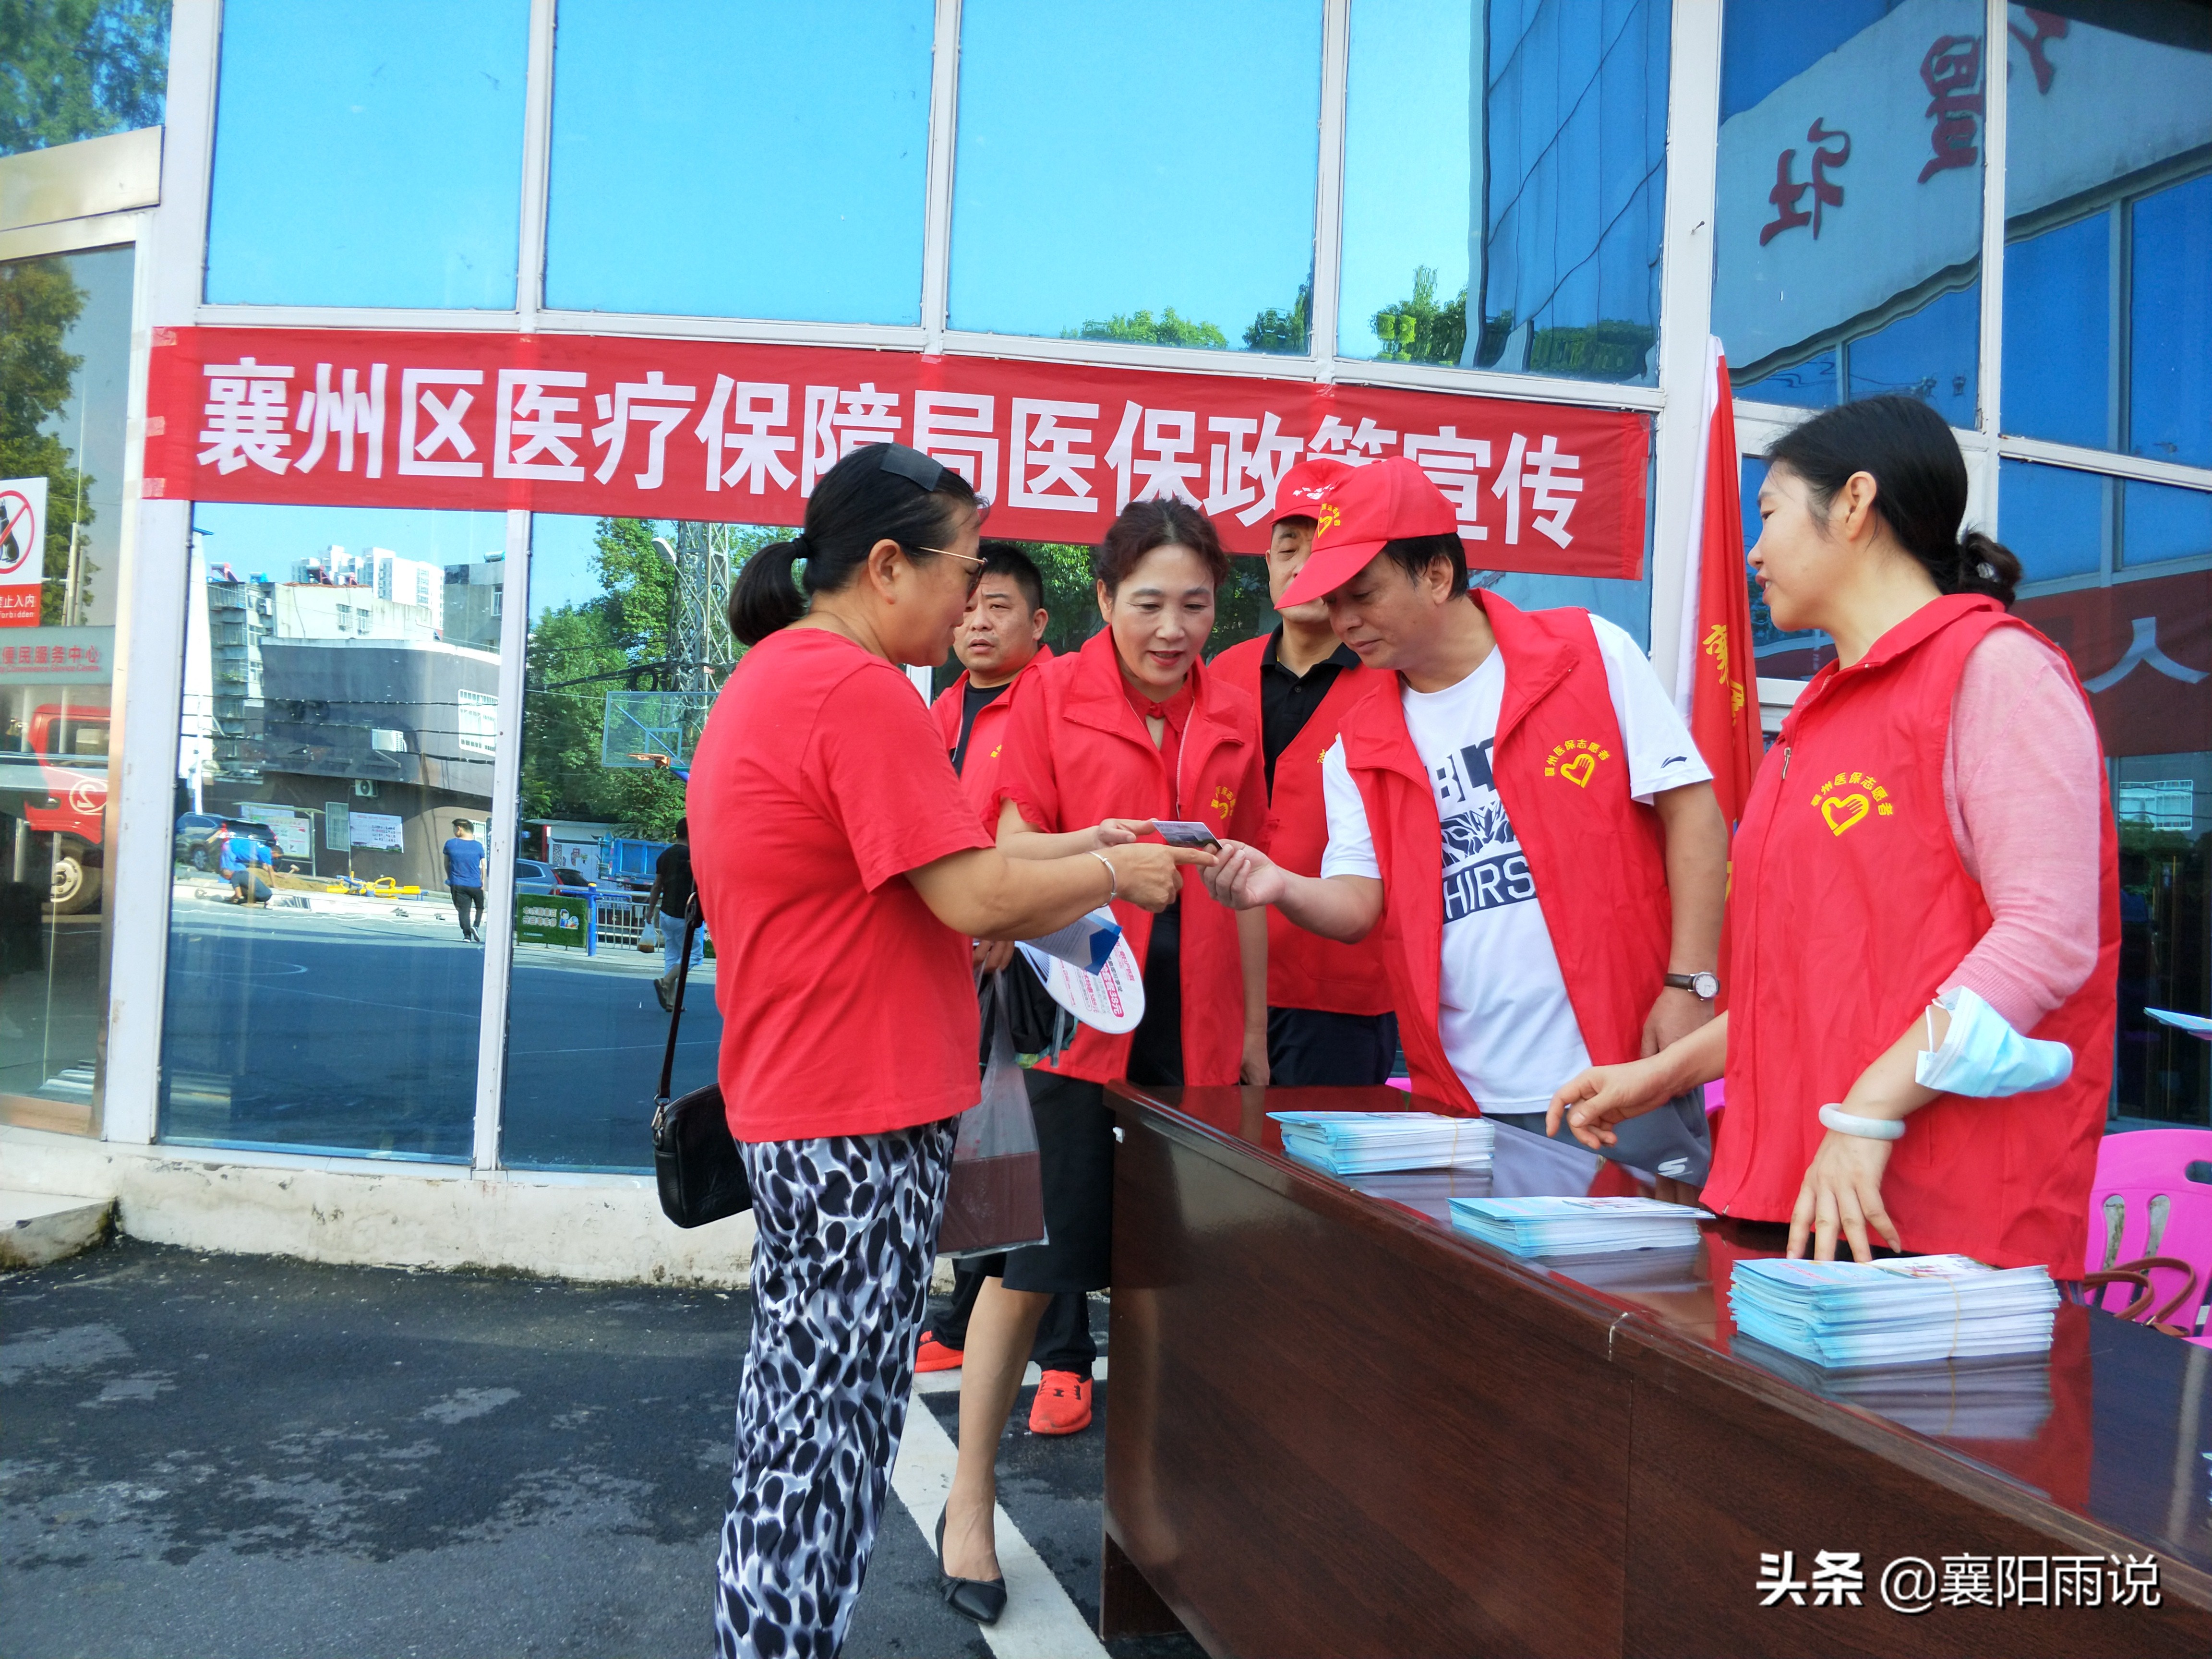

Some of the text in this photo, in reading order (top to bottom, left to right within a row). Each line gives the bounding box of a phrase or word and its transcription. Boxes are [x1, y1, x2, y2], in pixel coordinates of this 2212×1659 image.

[2, 645, 100, 664] 便民服务中心
